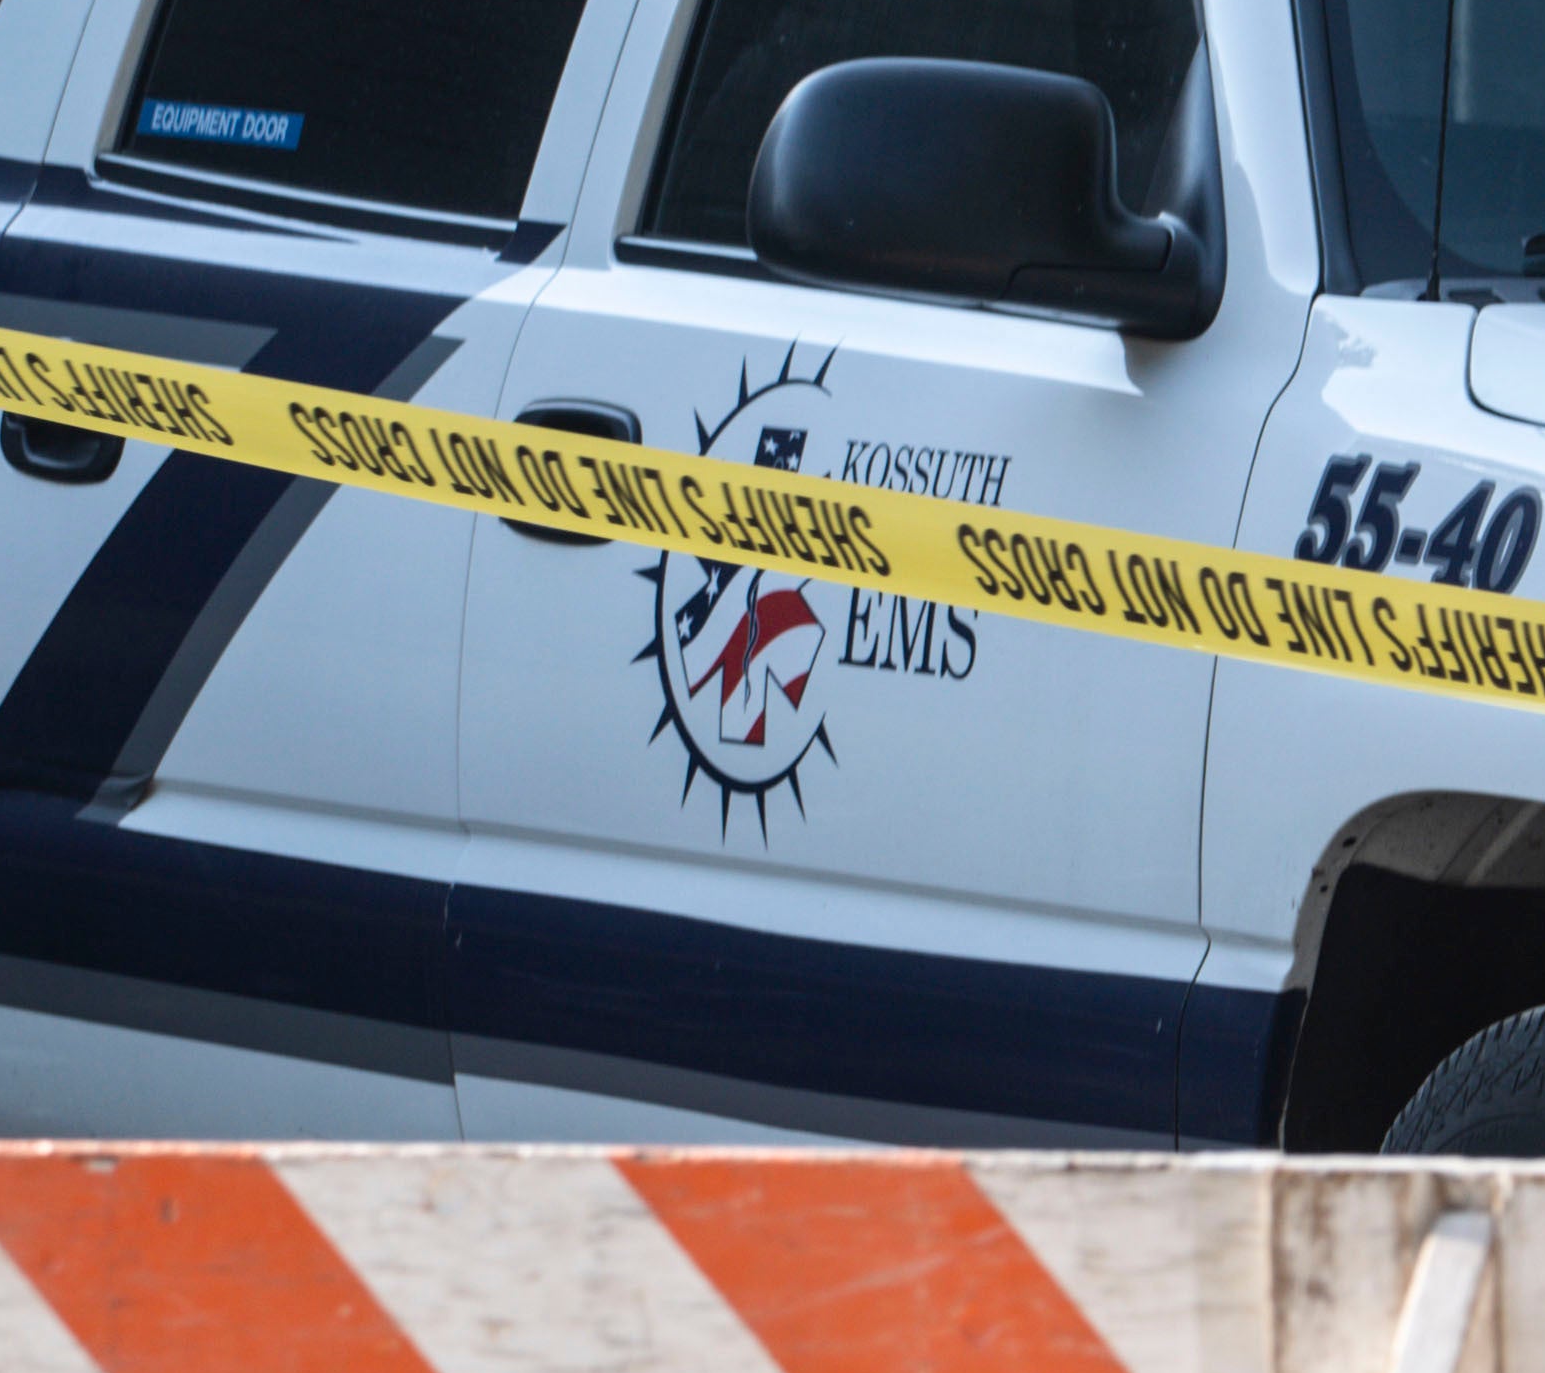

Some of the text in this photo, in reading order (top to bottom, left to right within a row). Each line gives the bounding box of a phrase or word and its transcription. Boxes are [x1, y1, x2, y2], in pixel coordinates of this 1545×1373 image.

[151, 103, 290, 143] EQUIPMENT DOOR
[25, 351, 234, 446] SHERIFF'S
[287, 400, 892, 576] SHERIFF'S LINE DO NOT CROSS
[841, 439, 1012, 507] KOSSUTH
[1294, 452, 1543, 595] 55-40
[956, 522, 1106, 624] CROSS
[1107, 548, 1201, 634] NOT
[1198, 566, 1270, 647] DO
[838, 587, 979, 681] EMS
[1264, 576, 1375, 665] LINE
